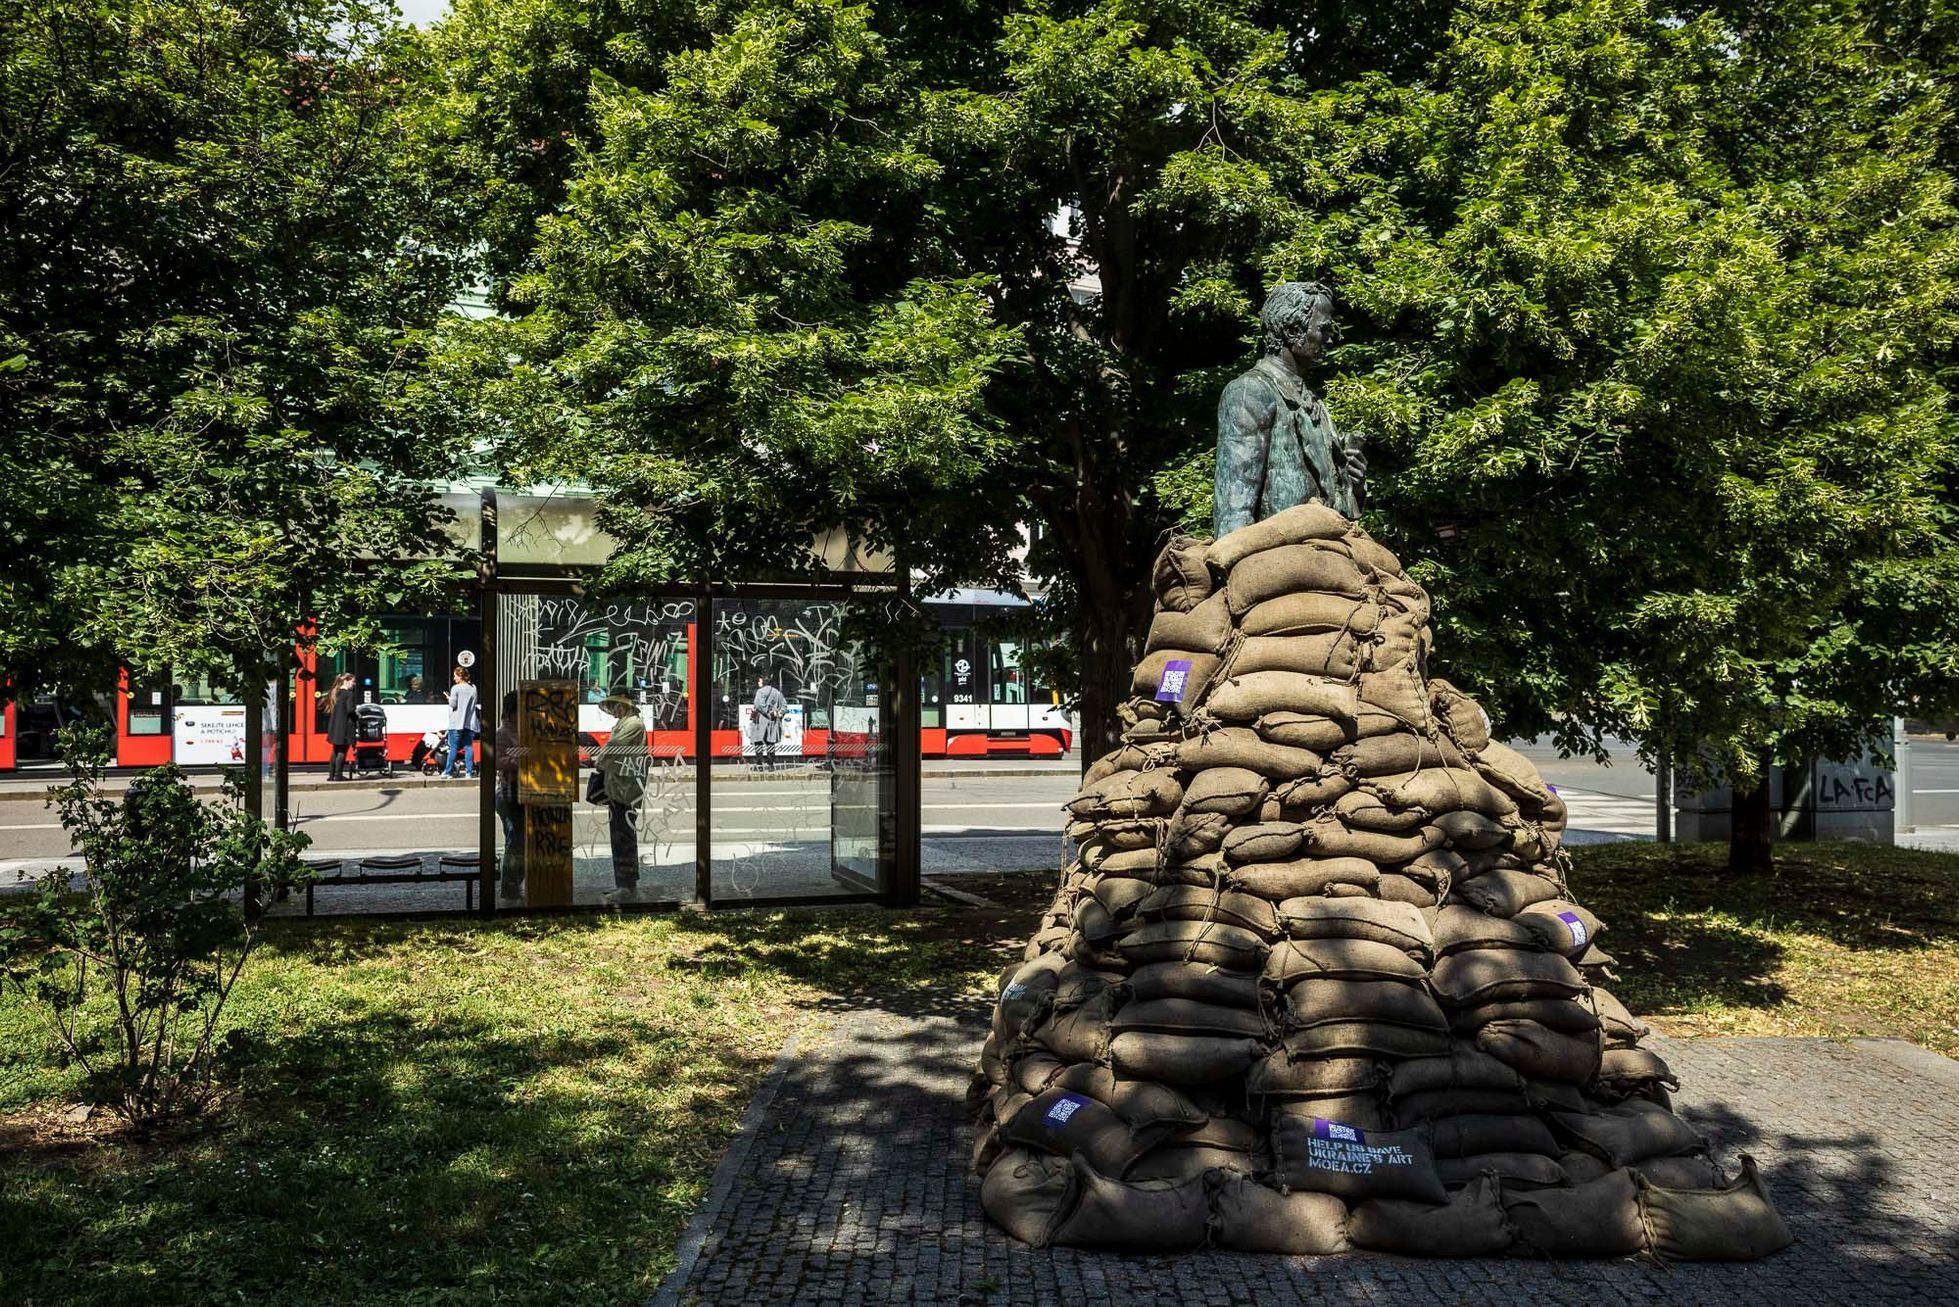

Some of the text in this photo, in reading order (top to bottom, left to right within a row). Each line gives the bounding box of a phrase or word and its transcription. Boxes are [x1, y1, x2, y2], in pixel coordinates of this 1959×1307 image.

[954, 694, 972, 702] 9341
[1308, 1137, 1342, 1150] HELP
[1308, 1147, 1414, 1165] UKRAINE'S ART
